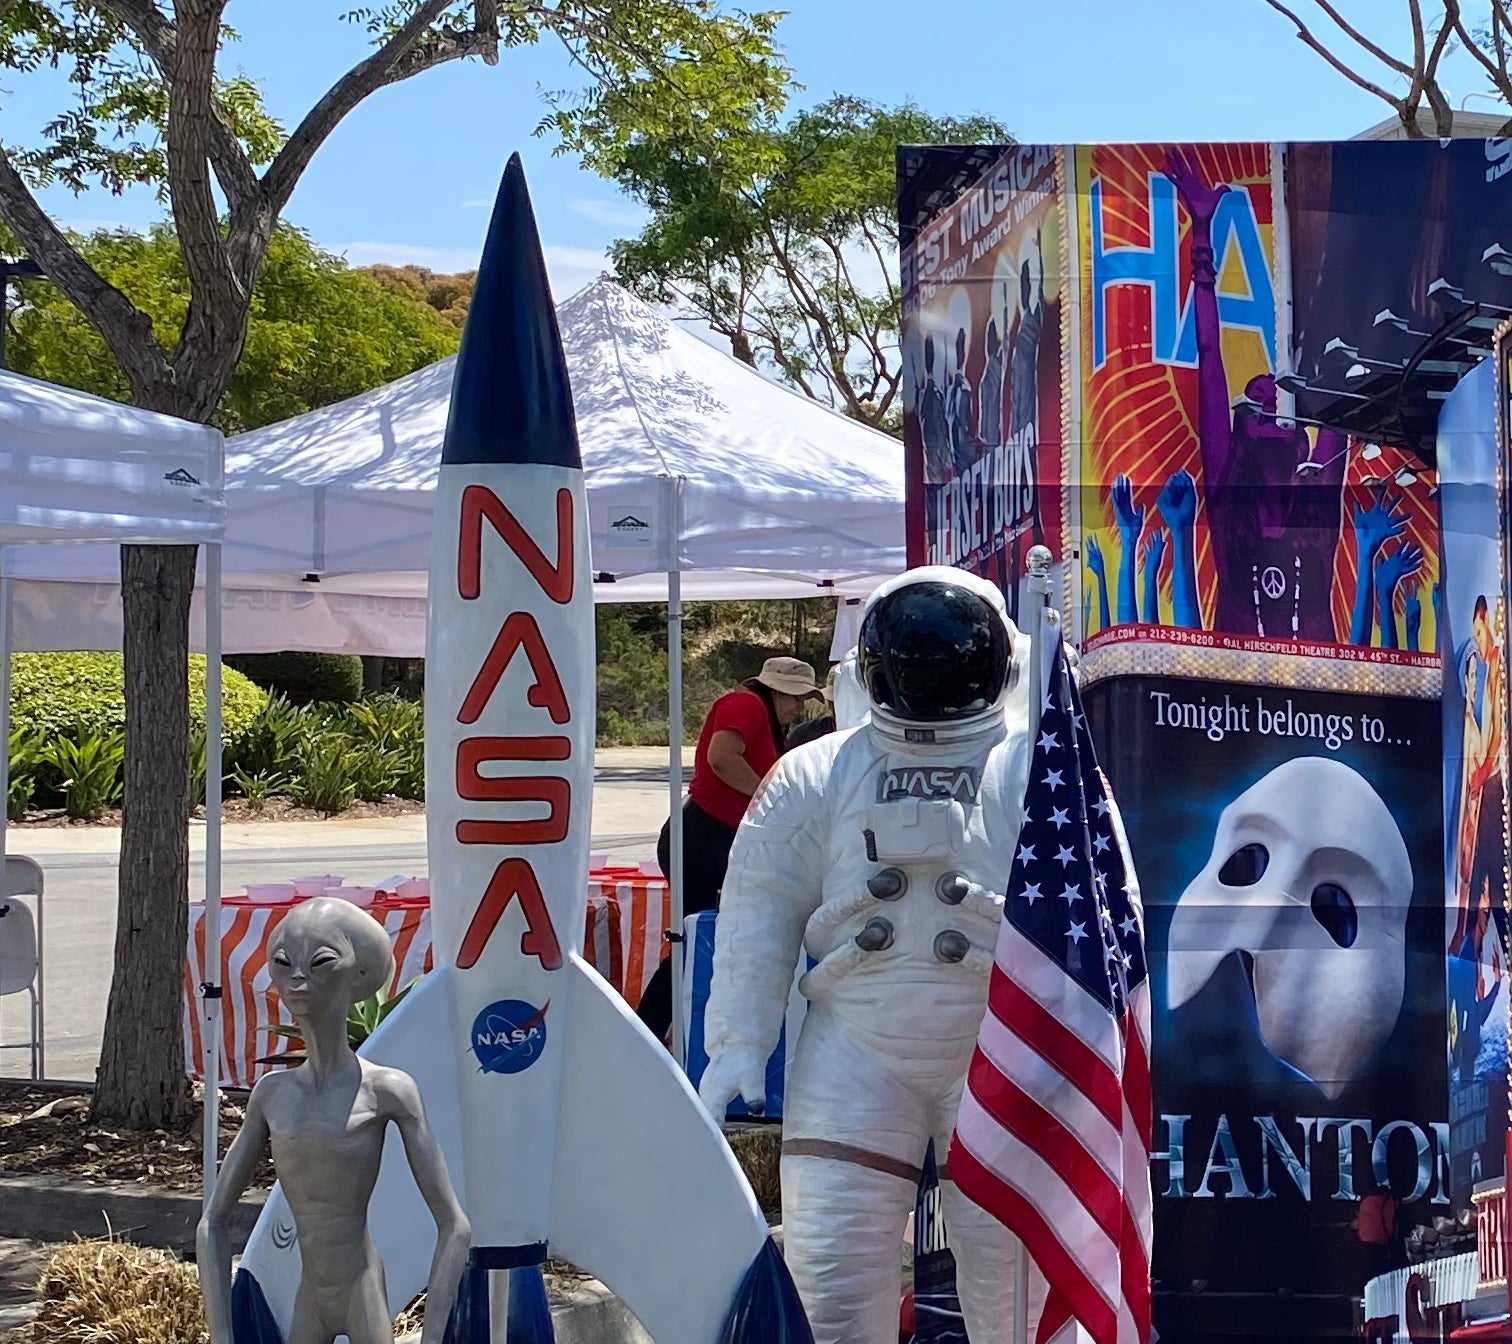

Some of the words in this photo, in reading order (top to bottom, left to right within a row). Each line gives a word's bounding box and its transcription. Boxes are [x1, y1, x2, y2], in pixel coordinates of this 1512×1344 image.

[940, 255, 968, 288] Tony
[971, 213, 1012, 264] Award
[1088, 171, 1276, 373] HA
[993, 422, 1034, 535] BOYS
[1300, 645, 1336, 658] THEATRE
[456, 484, 573, 970] NASA
[1150, 691, 1250, 742] Tonight
[1257, 697, 1353, 750] belongs
[882, 772, 975, 799] NASA
[477, 1028, 541, 1045] NASA
